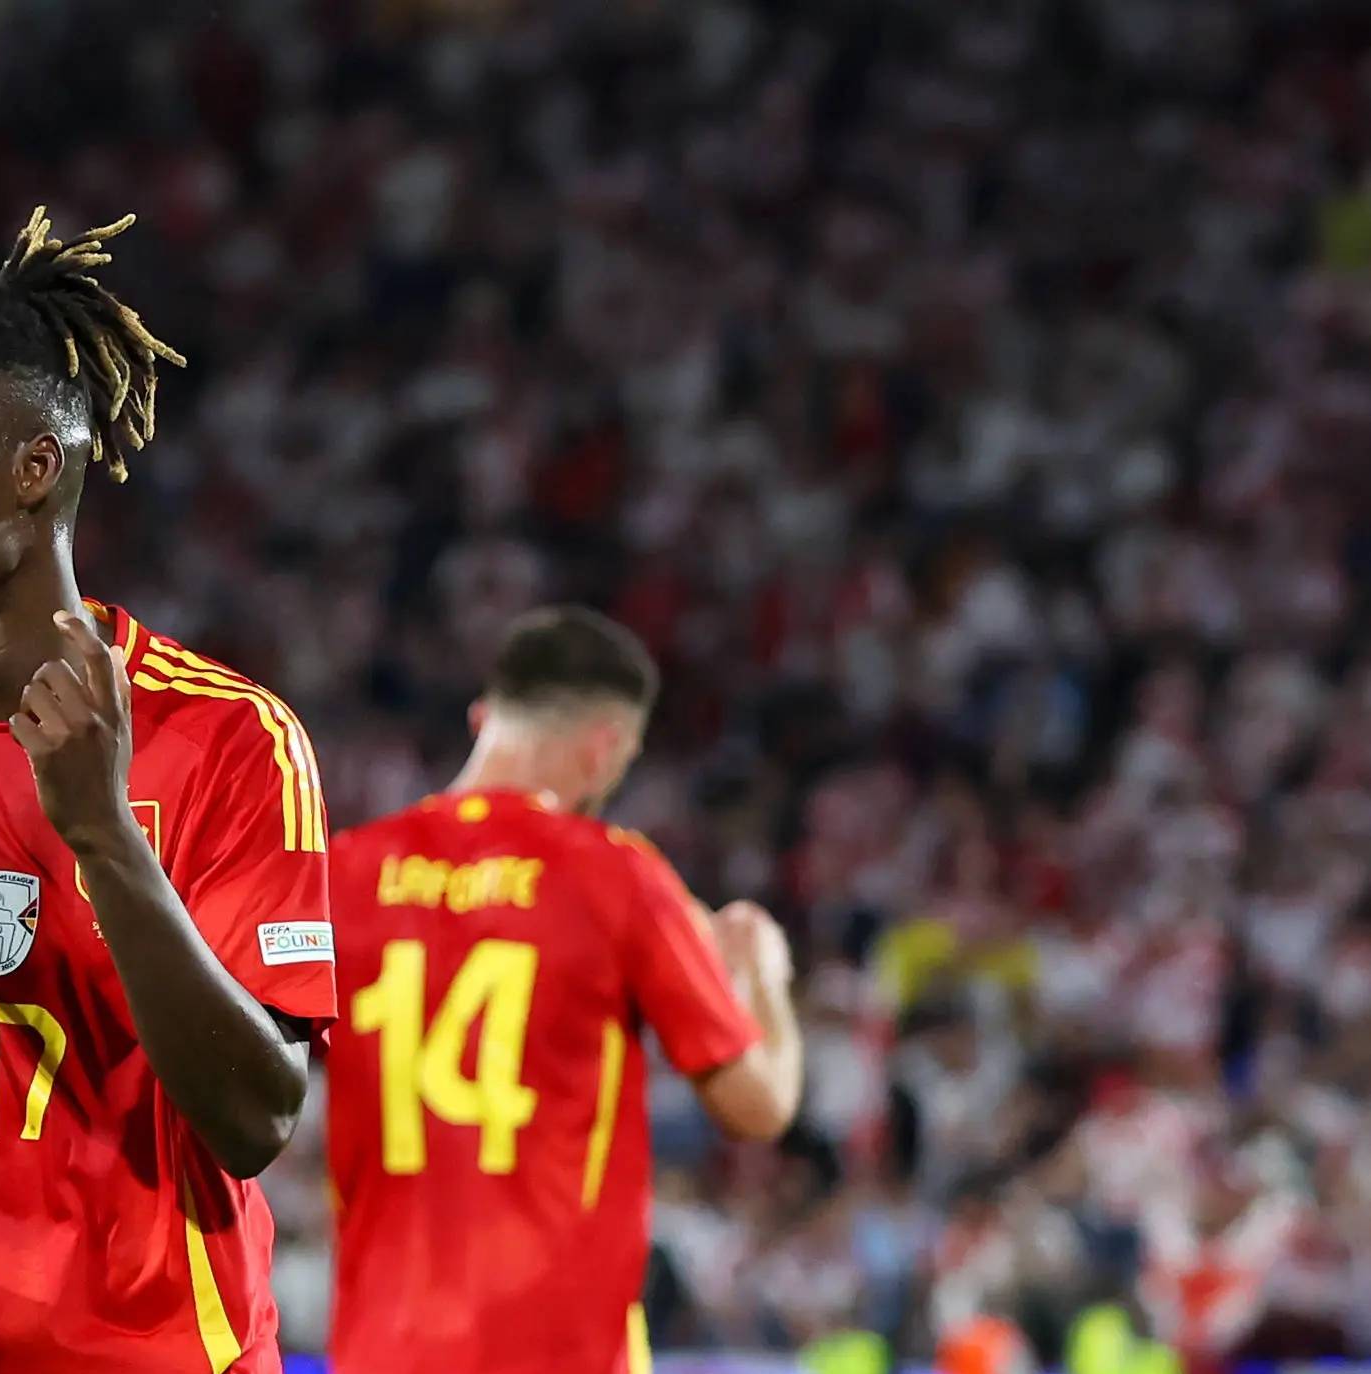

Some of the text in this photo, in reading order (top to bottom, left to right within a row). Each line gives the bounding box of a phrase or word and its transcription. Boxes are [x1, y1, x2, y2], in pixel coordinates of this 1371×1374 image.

[8, 875, 34, 885] LEAGUE
[263, 925, 290, 935] UEFA
[353, 939, 539, 1175] 14
